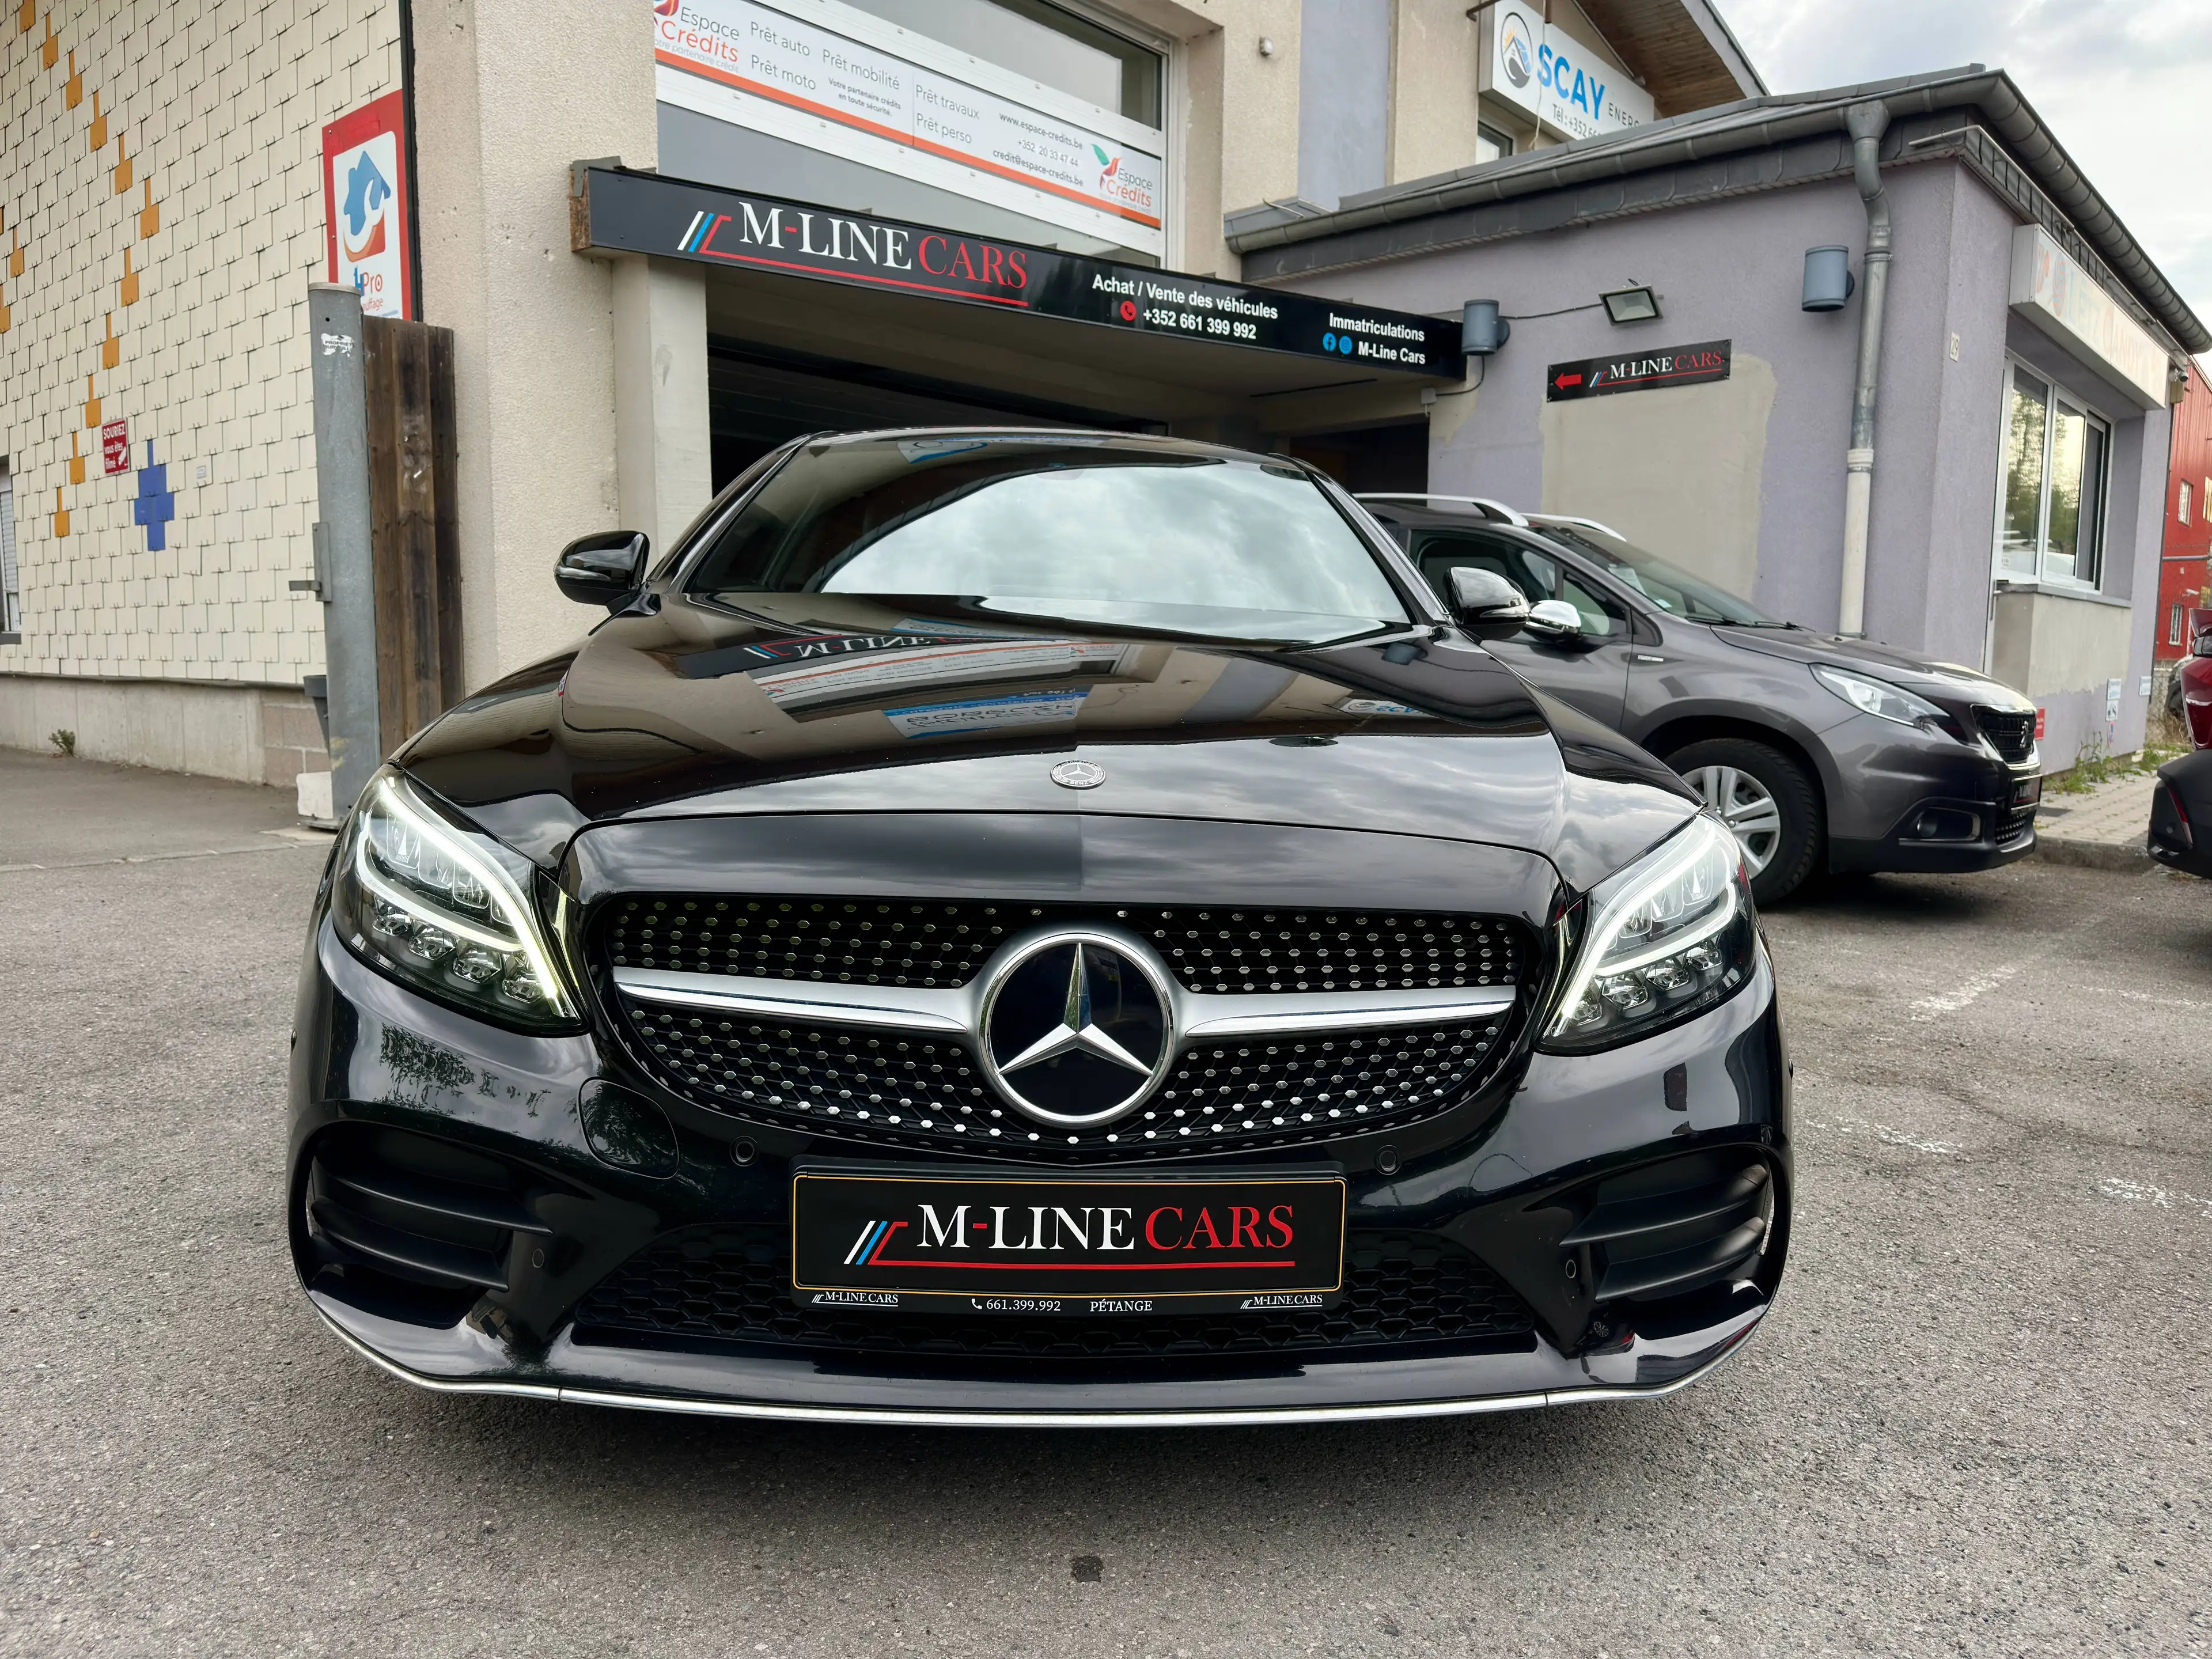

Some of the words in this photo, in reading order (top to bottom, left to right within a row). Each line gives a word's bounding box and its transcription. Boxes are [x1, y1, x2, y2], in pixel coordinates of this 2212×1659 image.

[681, 7, 739, 40] Espace
[751, 21, 778, 45] Prêt
[781, 37, 810, 56] auto
[654, 39, 671, 50] otre
[672, 45, 715, 65] partenaire
[661, 20, 738, 62] Crédits
[752, 54, 778, 77] Prêt
[782, 70, 816, 90] moto
[823, 49, 847, 71] Prêt
[851, 63, 900, 89] mobilité
[1537, 43, 1605, 120] SCAY
[828, 77, 846, 90] Votre
[847, 86, 880, 101] partenaire
[847, 95, 865, 107] toute
[916, 84, 938, 105] Prêt
[941, 96, 980, 120] travaux
[916, 112, 938, 132] Prêt
[941, 126, 972, 143] perso
[999, 113, 1083, 149] www.espace-credits.be
[1018, 139, 1036, 153] +352
[1039, 146, 1048, 157] 20
[1049, 150, 1058, 161] 33
[1059, 154, 1068, 164] 47
[1069, 158, 1079, 166] 44
[993, 150, 1084, 186] credit@espace-credits.be
[1118, 168, 1153, 191] Espace
[1107, 179, 1152, 207] Crédits
[739, 201, 912, 270] M-LINE
[918, 235, 1028, 289] CARS
[1092, 274, 1135, 296] Achat
[1137, 281, 1143, 297] /
[1146, 282, 1185, 304] Vente
[1188, 290, 1213, 309] des
[1216, 296, 1278, 319] véhicules
[1143, 308, 1176, 327] +352
[1180, 313, 1202, 331] 661
[1207, 317, 1230, 335] 399
[1233, 321, 1256, 340] 992
[1329, 312, 1425, 342] Immatriculations
[1358, 340, 1397, 361] M-Line
[1400, 347, 1426, 365] Cars
[1610, 357, 1672, 379] M-LINE
[1675, 350, 1723, 370] CARS
[104, 422, 125, 440] SOURIEZ
[104, 445, 115, 454] vous
[916, 1204, 1134, 1251] M-LINE
[1145, 1204, 1294, 1250] CARS
[825, 1291, 867, 1302] M-LINE
[868, 1293, 898, 1304] CARS
[986, 1299, 1061, 1311] 661.399.992
[1090, 1298, 1153, 1312] PÉTANGE
[1253, 1296, 1293, 1305] M-LINE
[1294, 1294, 1323, 1304] CARS
